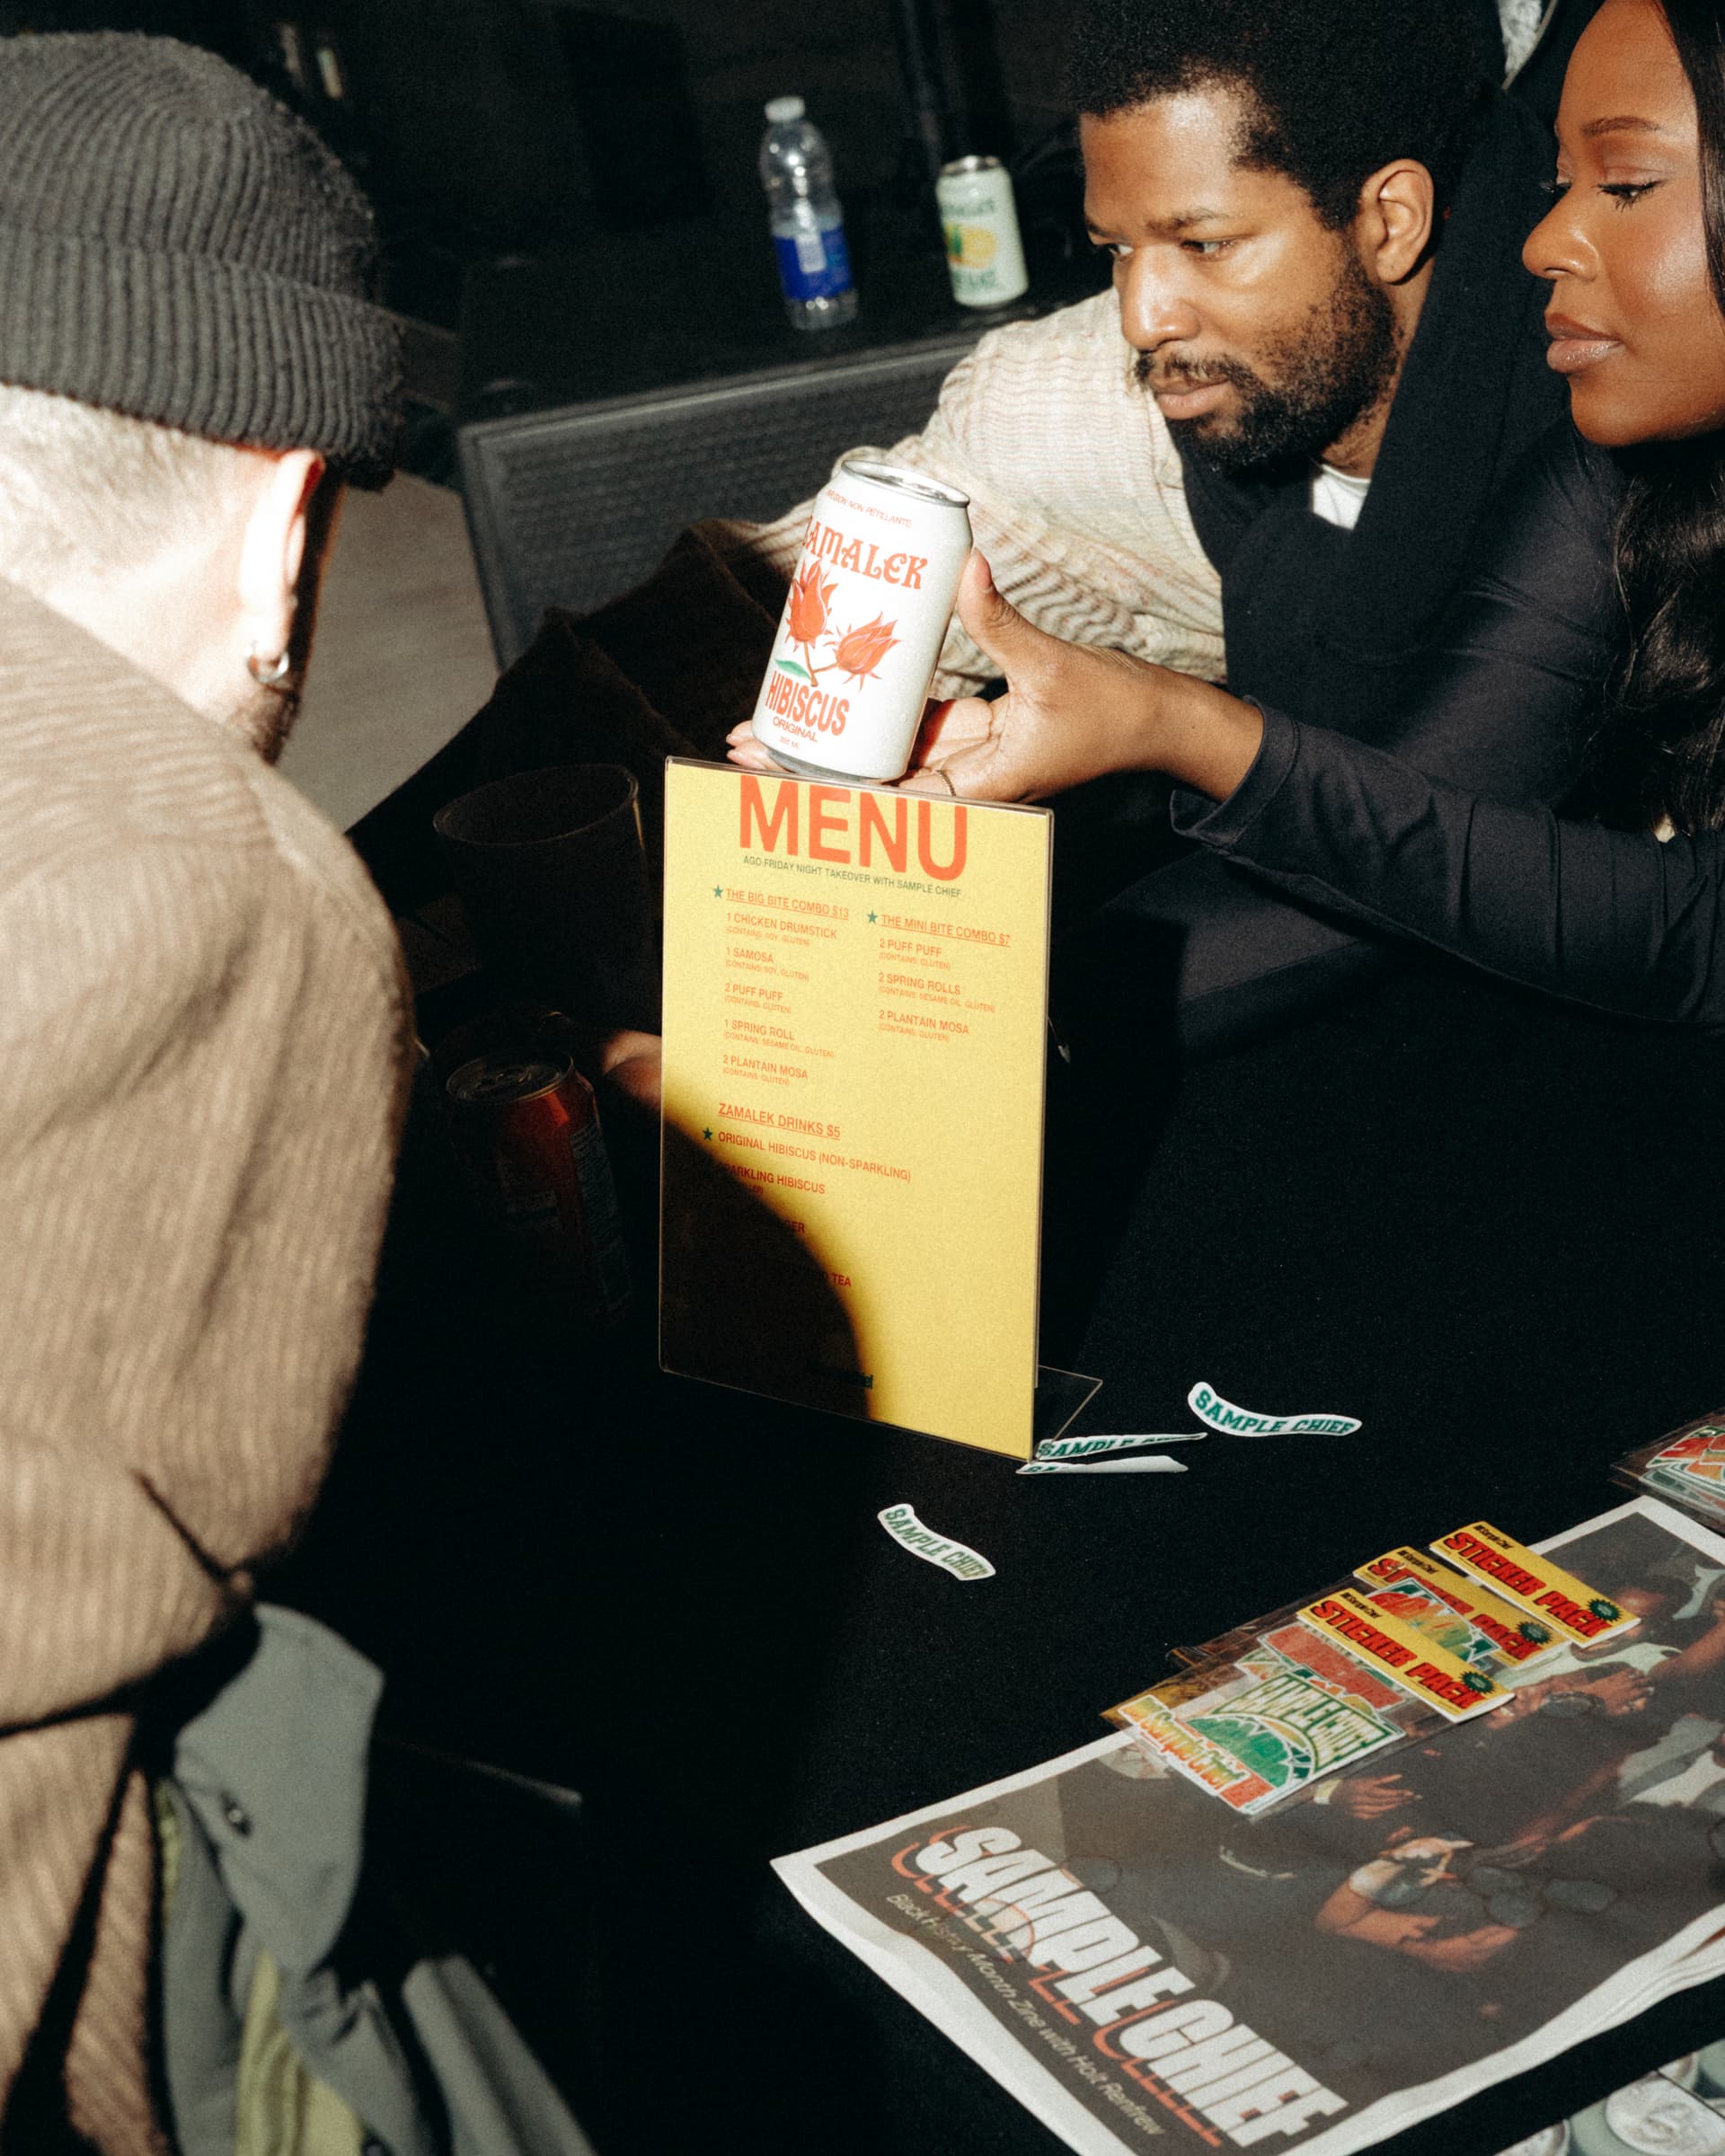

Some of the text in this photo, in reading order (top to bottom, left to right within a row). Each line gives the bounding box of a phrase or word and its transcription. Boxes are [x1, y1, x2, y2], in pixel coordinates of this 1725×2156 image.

[804, 517, 928, 589] AMALEK
[765, 673, 850, 736] HIBISCUS
[773, 716, 818, 742] ORIGINAL
[739, 774, 968, 881] MENU
[743, 855, 962, 898] AGO FRIDAY NIGHT TAKEOVER WITH SAMPLE CHIEF
[726, 888, 745, 899] THE
[748, 892, 765, 904] BIG
[767, 895, 789, 908] BITE
[792, 899, 829, 915] COMBO
[727, 913, 837, 940] 1 CHICKEN DRUMSTICK
[881, 915, 1011, 945] THE MINI BITE COMBO $7
[726, 947, 774, 963] 1 SAMOSA
[880, 938, 942, 957] 2 PUFF PUFF
[724, 983, 783, 1001] 2 PUFF PUFF
[879, 971, 960, 995] 2 SPRING ROLLS
[724, 1020, 795, 1040] 1 SPRING ROLL
[879, 1010, 969, 1035] 2 PLANTAIN MOSA
[723, 1055, 809, 1079] 2 PLANTAIN MOSA
[719, 1103, 774, 1124] ZAMALEK
[778, 1115, 823, 1135] DRINKS
[719, 1131, 911, 1184] ORIGINAL HIBISCUS (NON-SPARKLING)
[777, 1176, 826, 1195] HIBISCUS
[831, 1272, 852, 1287] TEA
[1195, 1389, 1356, 1436] SAMPLE CHIEF
[884, 1507, 987, 1579] SAMPLE CHIEF
[1443, 1532, 1547, 1596] STICKER
[1533, 1590, 1613, 1638] PACK
[1310, 1600, 1418, 1667] STICKER
[1404, 1662, 1486, 1710] PACK
[903, 1826, 1349, 2148] SAMPLE CHIEF
[886, 1894, 931, 1922] Black
[967, 1948, 1017, 1999] Month
[1007, 1999, 1047, 2035] Zine
[1039, 2028, 1076, 2063] with
[1099, 2081, 1166, 2136] Renfrew
